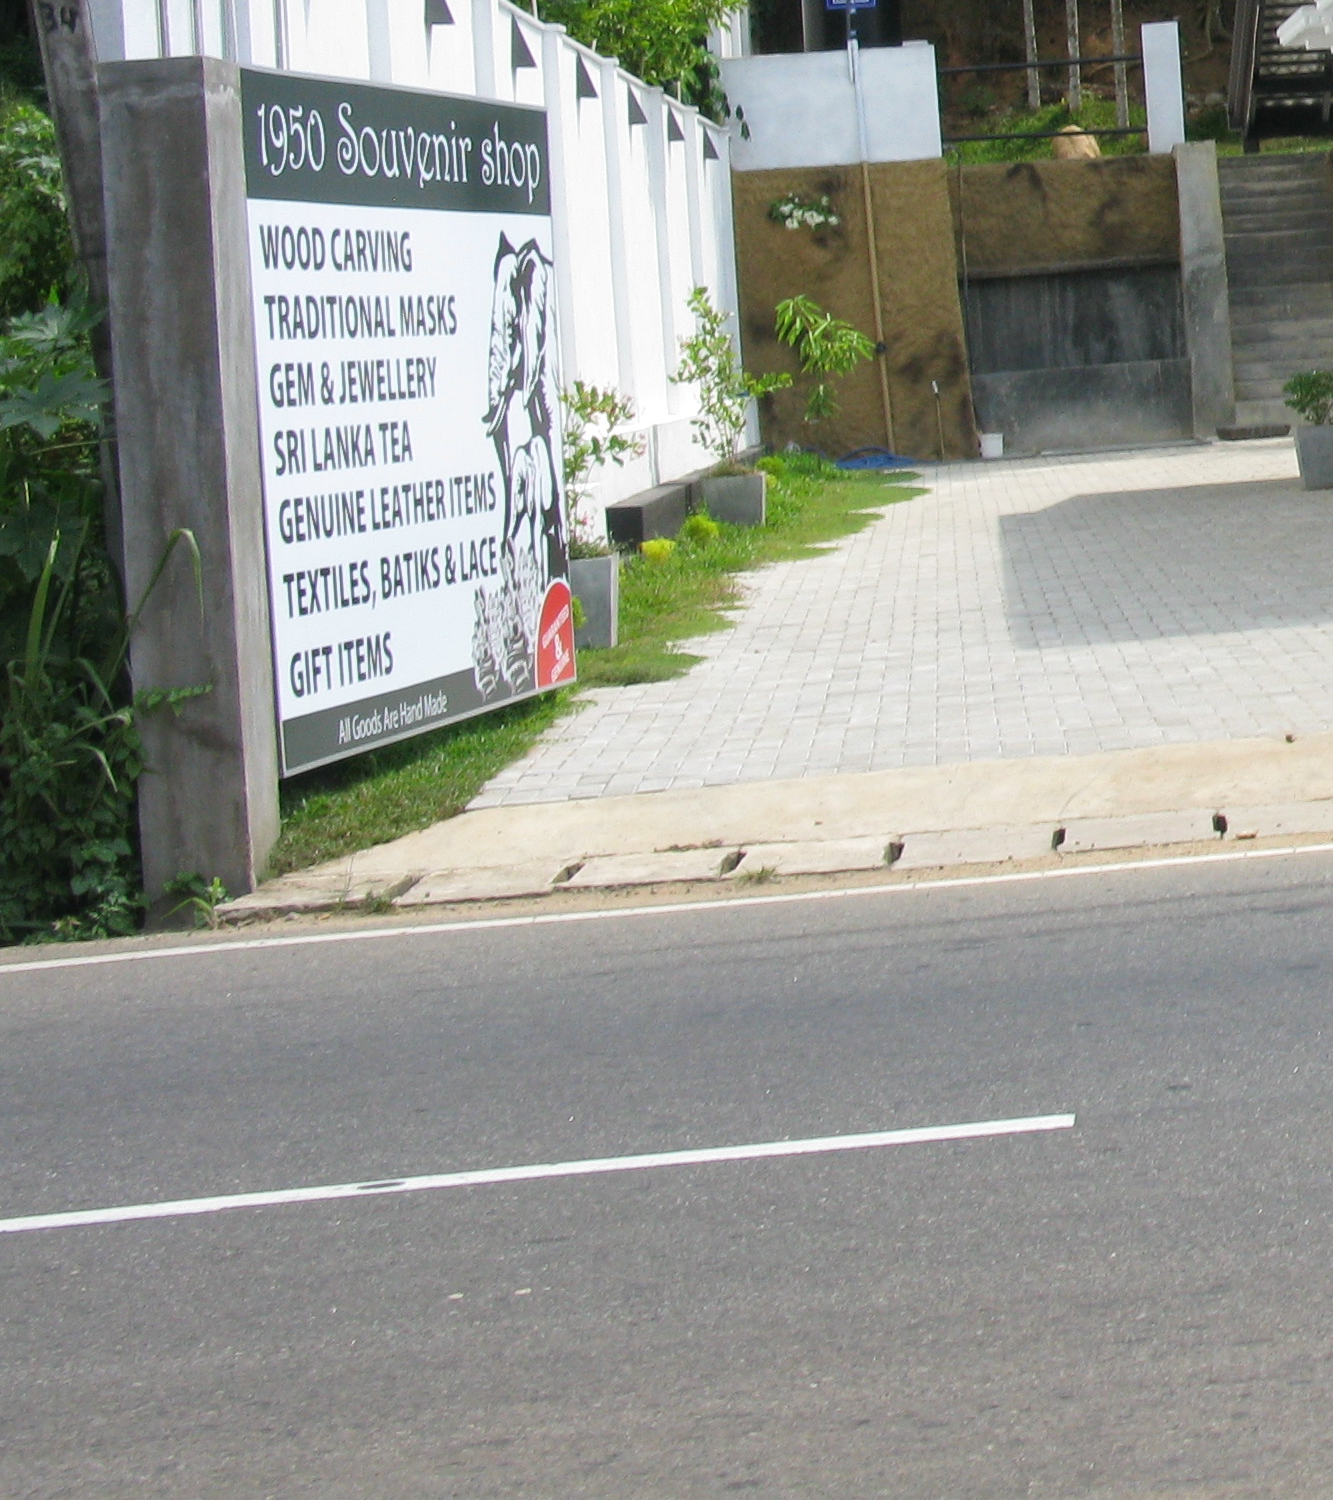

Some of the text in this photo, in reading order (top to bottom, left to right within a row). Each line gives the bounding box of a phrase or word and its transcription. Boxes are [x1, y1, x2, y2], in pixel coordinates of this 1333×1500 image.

[257, 102, 541, 204] 1950 Souvenir shop
[259, 225, 413, 273] WOOD CARVING
[264, 295, 458, 340] TRADITIONAL MASKS
[270, 356, 438, 408] GEM & JEWELLERY
[274, 420, 413, 476] SRI LANKA TEA
[279, 471, 496, 545] GENUINE LEATHER ITEMS
[283, 536, 498, 619] TEXTILES, BATIKS & LACE
[290, 631, 394, 698] GIFT ITEMS
[338, 689, 448, 745] All Goods Are Hand Made
